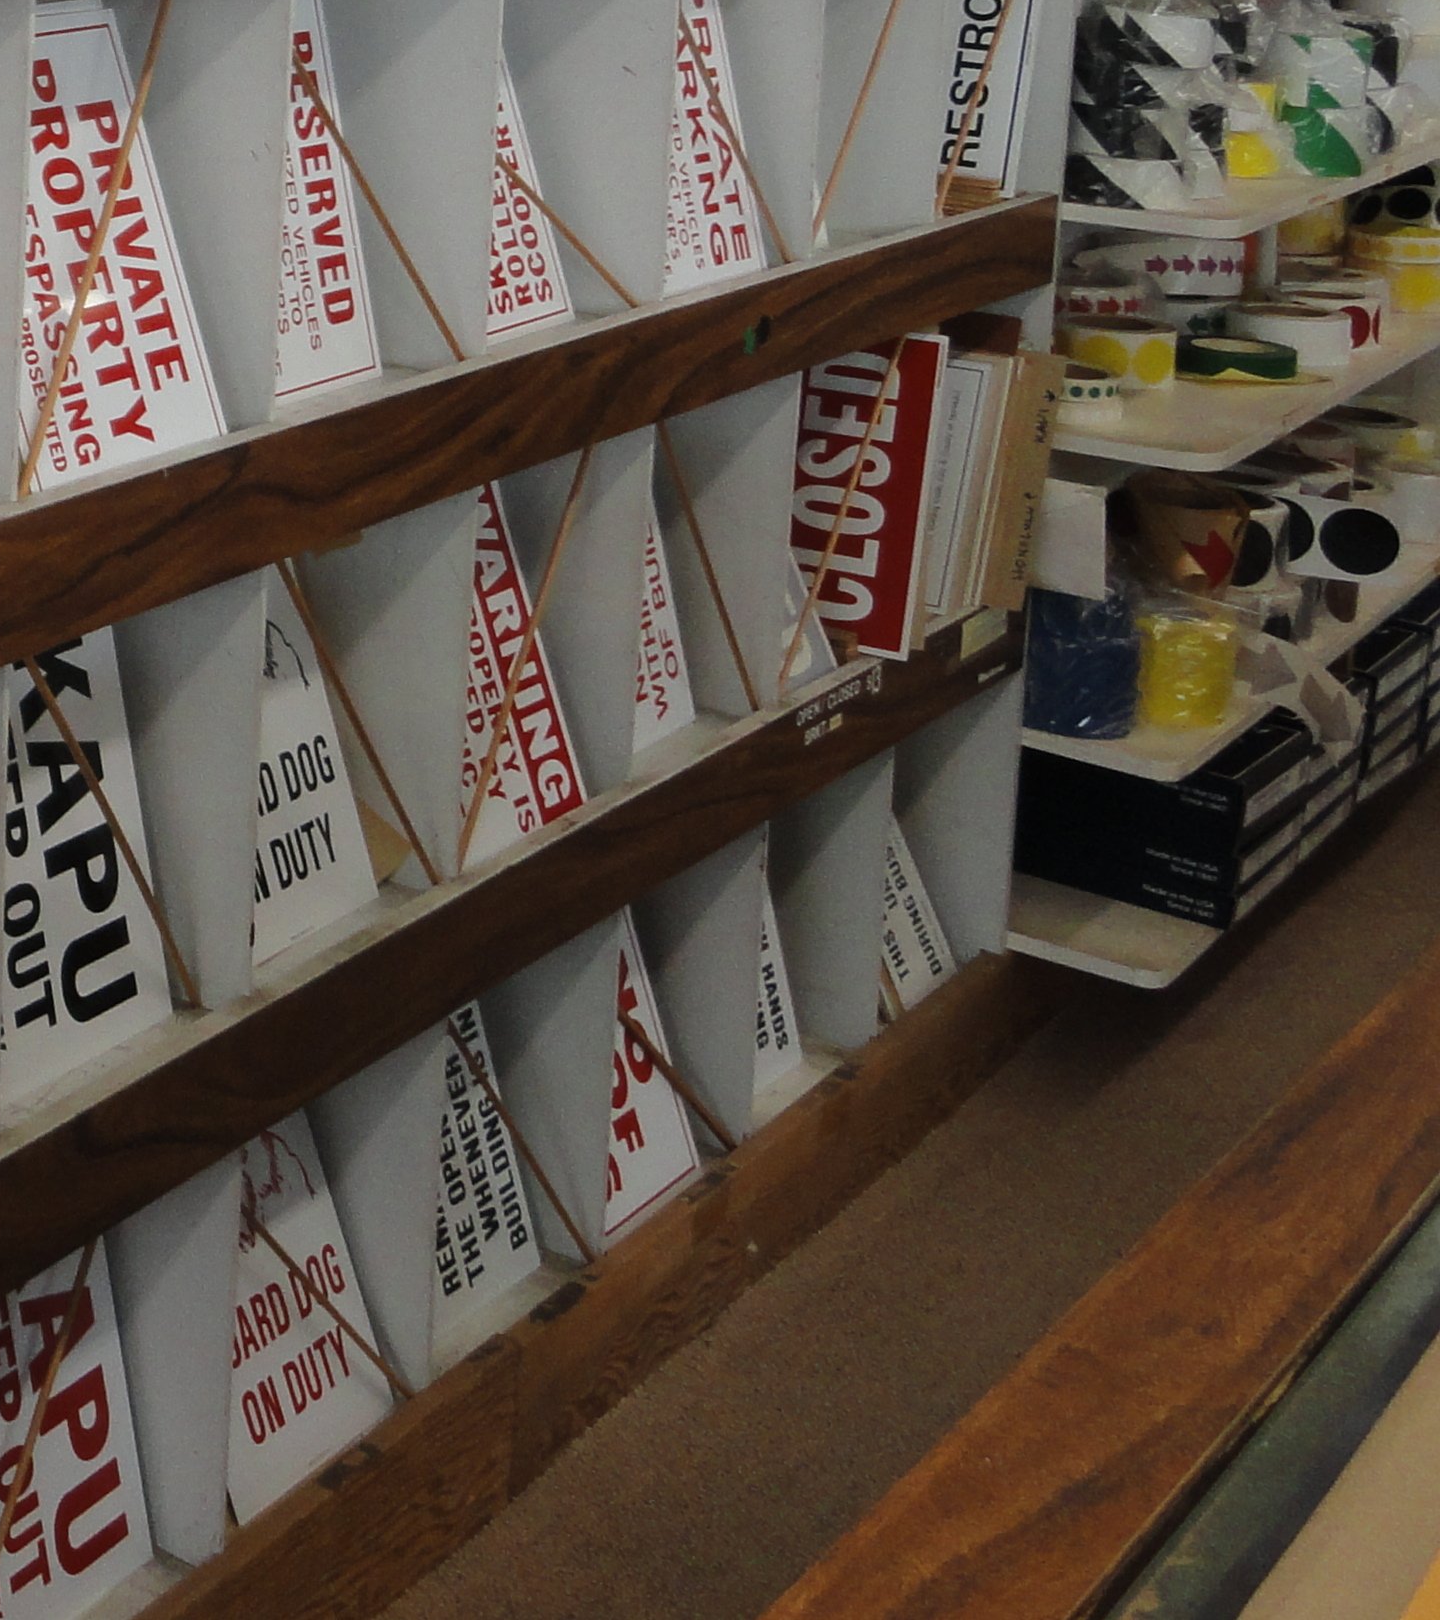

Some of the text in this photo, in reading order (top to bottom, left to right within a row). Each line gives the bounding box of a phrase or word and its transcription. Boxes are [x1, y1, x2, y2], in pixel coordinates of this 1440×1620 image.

[30, 58, 157, 443] PROPERTY
[77, 99, 190, 391] PRIVATE
[293, 227, 323, 352] VEHICLES
[791, 351, 903, 622] CLOSED
[477, 484, 571, 810] WARNING
[279, 734, 336, 802] DOG
[514, 796, 536, 833] IS
[15, 637, 138, 1026] KAPU
[279, 817, 337, 891] DUTY
[3, 883, 57, 1029] OUT
[883, 929, 911, 984] THIS
[904, 894, 943, 977] DURING
[762, 962, 789, 1050] HANDS
[447, 1053, 500, 1242] WHENEVER
[478, 1098, 528, 1251] BUILDING
[292, 1242, 346, 1318] DOG
[456, 1214, 485, 1287] THE
[19, 1286, 131, 1577] APU
[242, 1326, 353, 1447] ON DUTY
